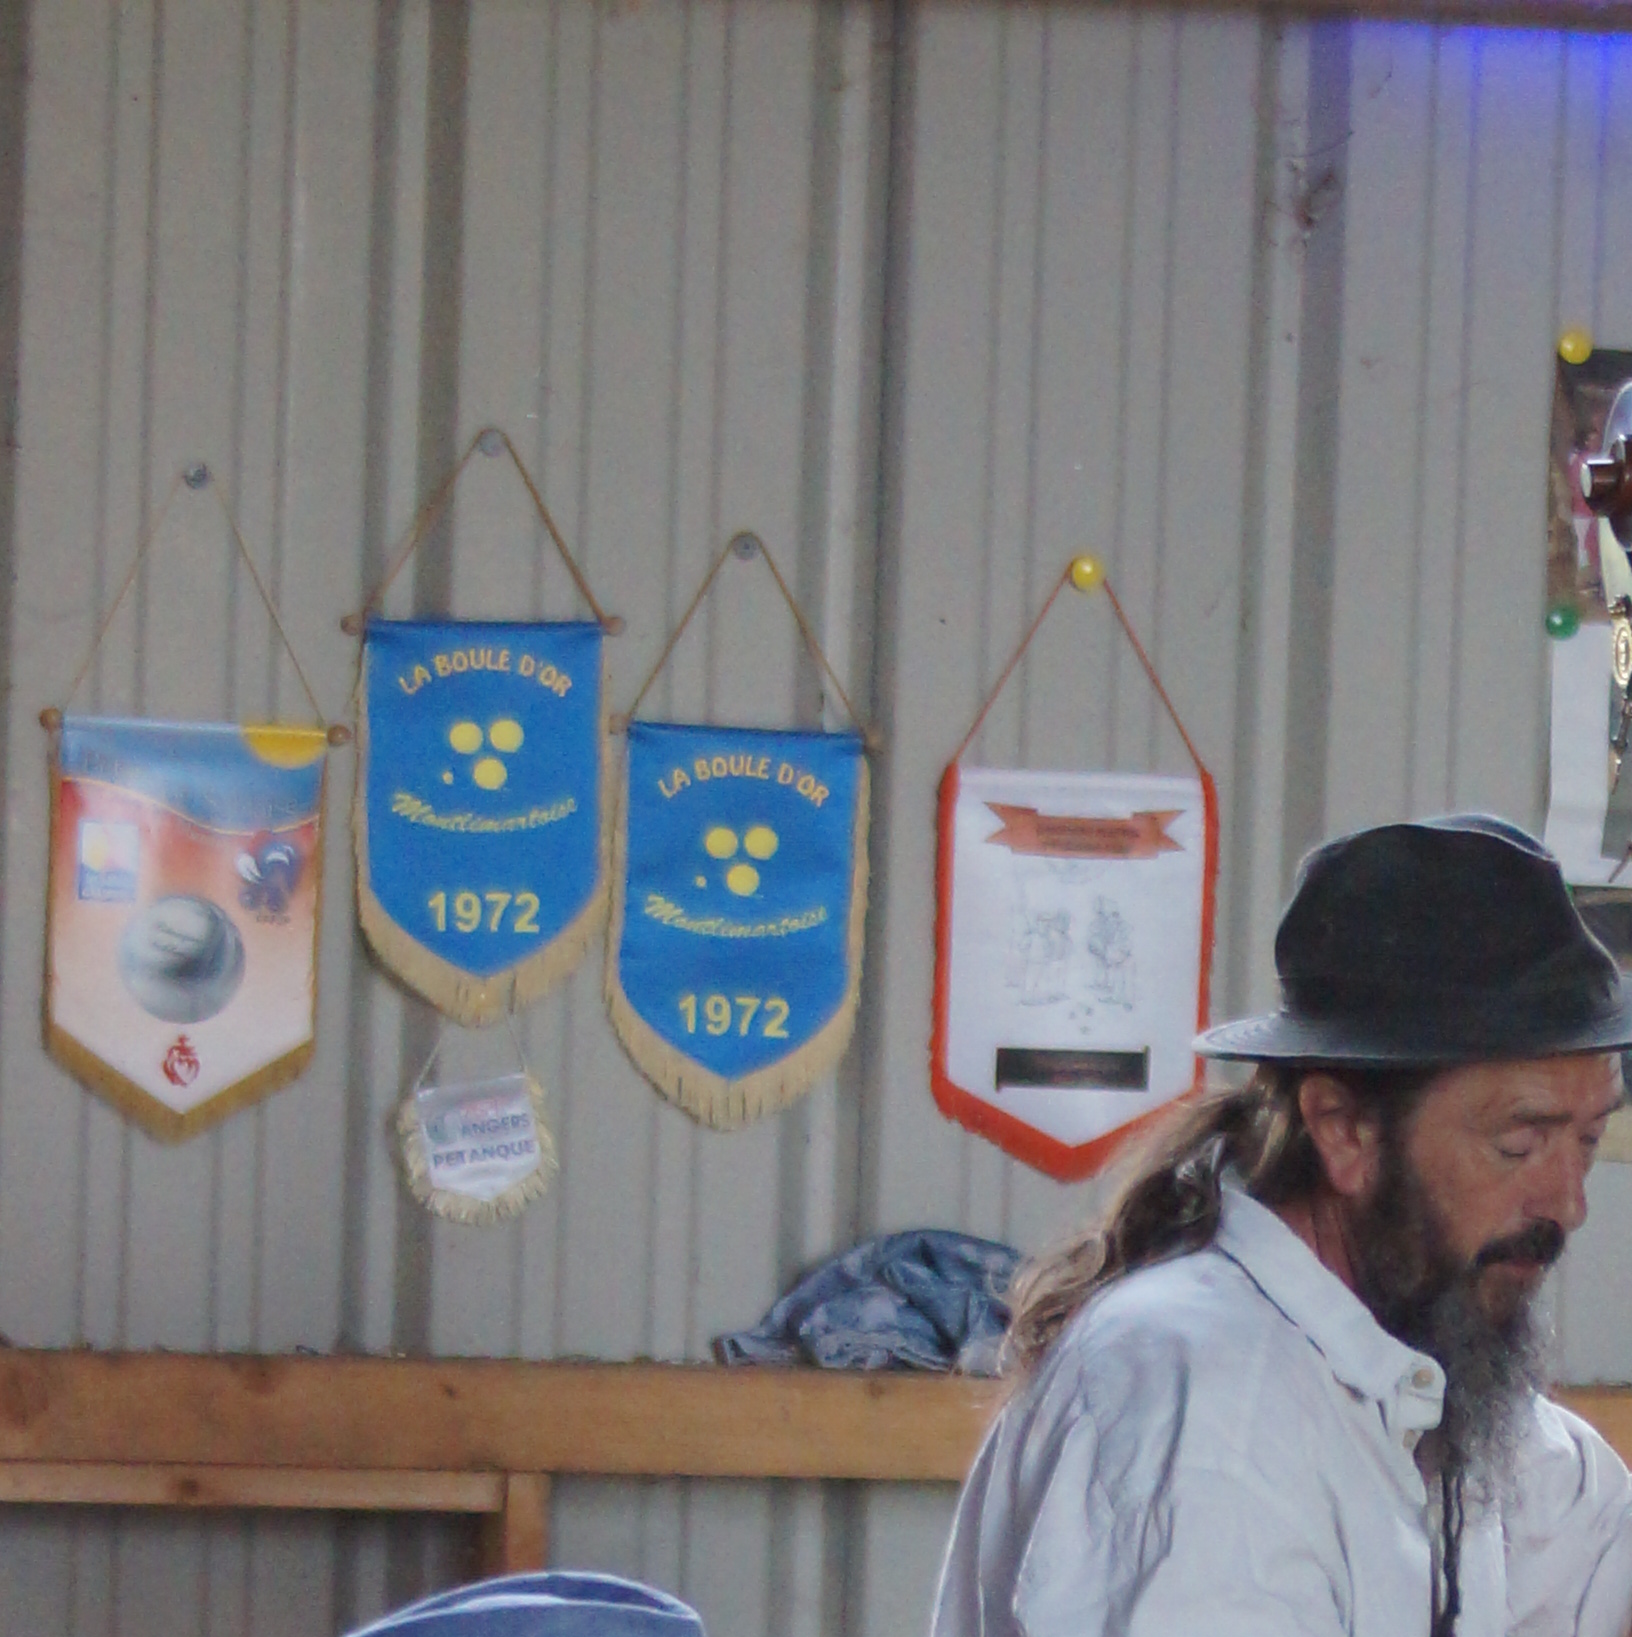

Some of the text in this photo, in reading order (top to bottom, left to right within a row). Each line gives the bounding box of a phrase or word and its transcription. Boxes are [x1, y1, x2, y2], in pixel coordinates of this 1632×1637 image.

[398, 648, 573, 698] LA BOULE D'OR
[657, 755, 830, 808] LA BOULE D'OR
[428, 891, 540, 933] 1972
[679, 994, 790, 1039] 1972
[460, 1112, 531, 1138] ANGERS
